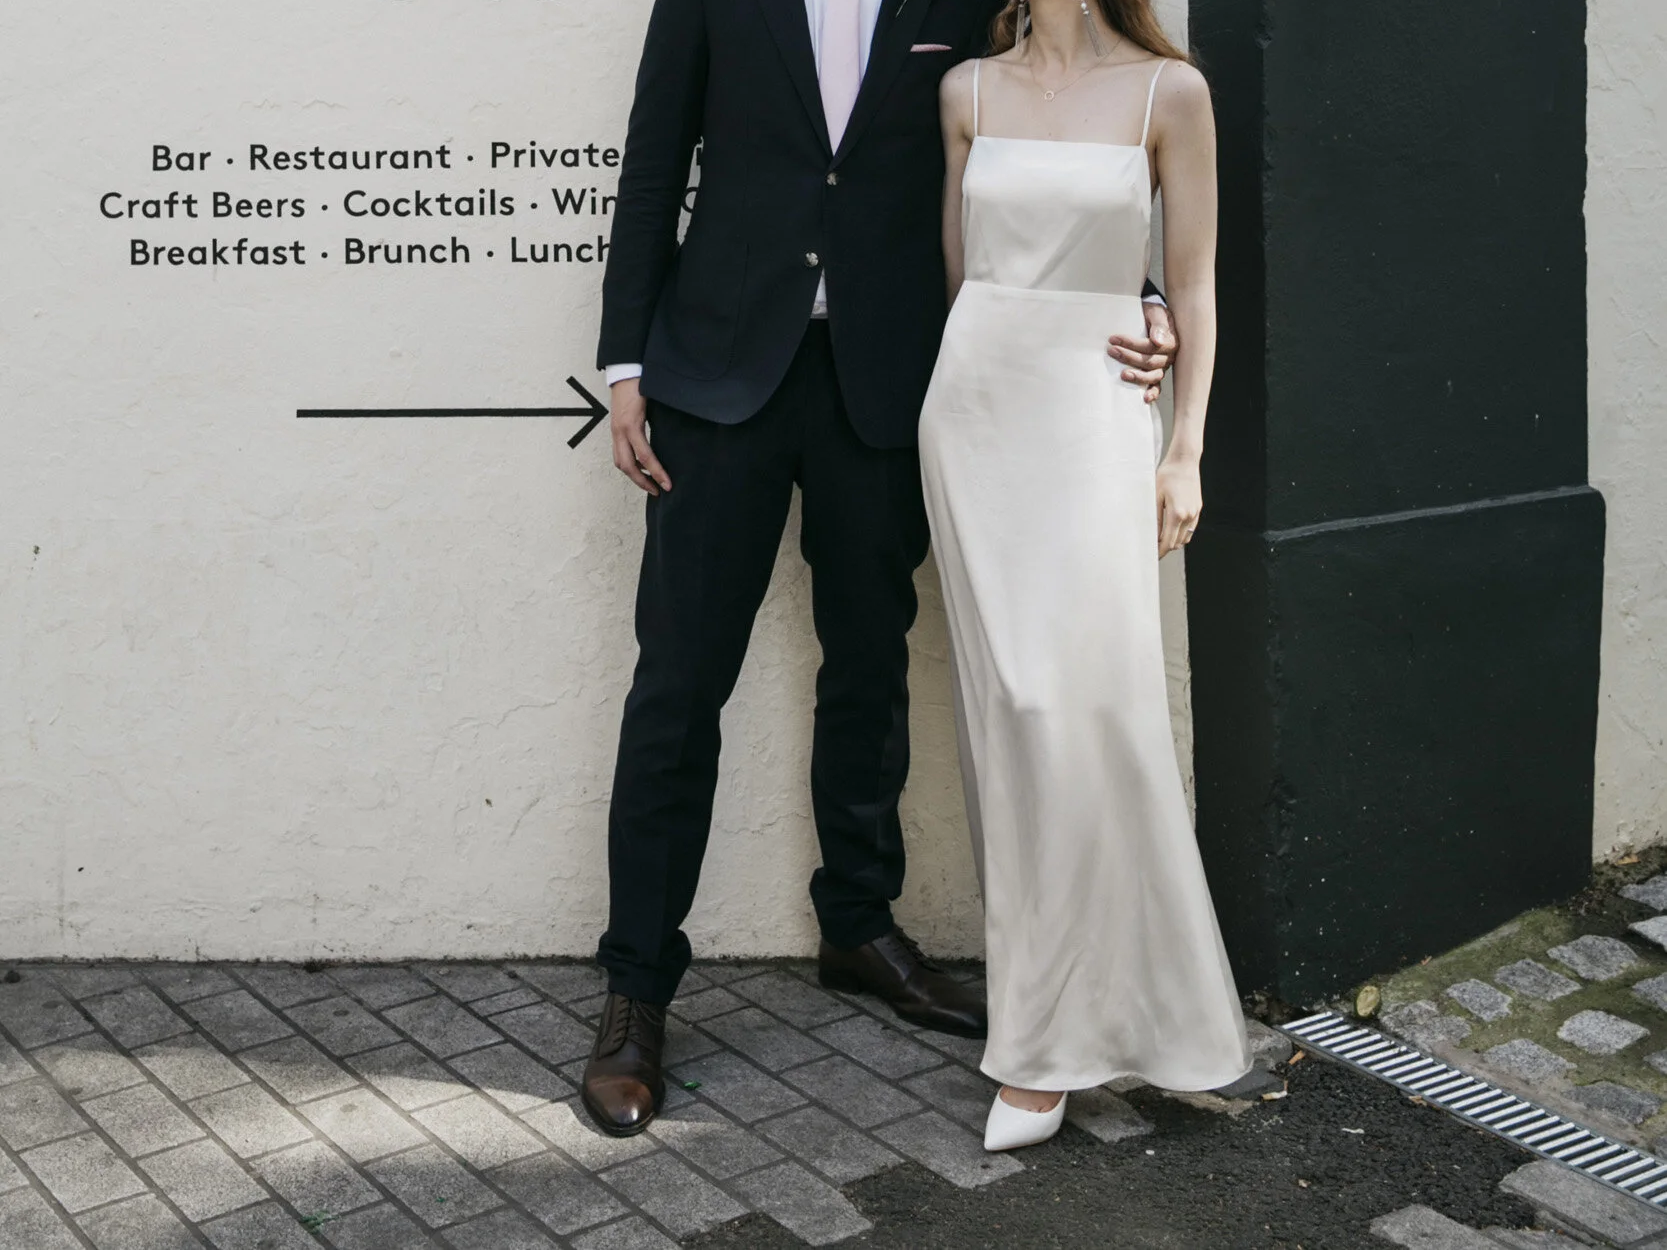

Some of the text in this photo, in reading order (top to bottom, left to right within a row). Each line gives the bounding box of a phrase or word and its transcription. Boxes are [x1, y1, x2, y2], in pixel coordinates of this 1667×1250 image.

[152, 140, 620, 172] Bar Restaurant Private
[99, 186, 618, 219] Craft Beers Cocktails Win
[130, 235, 611, 266] Breakfast Brunch Lunch
